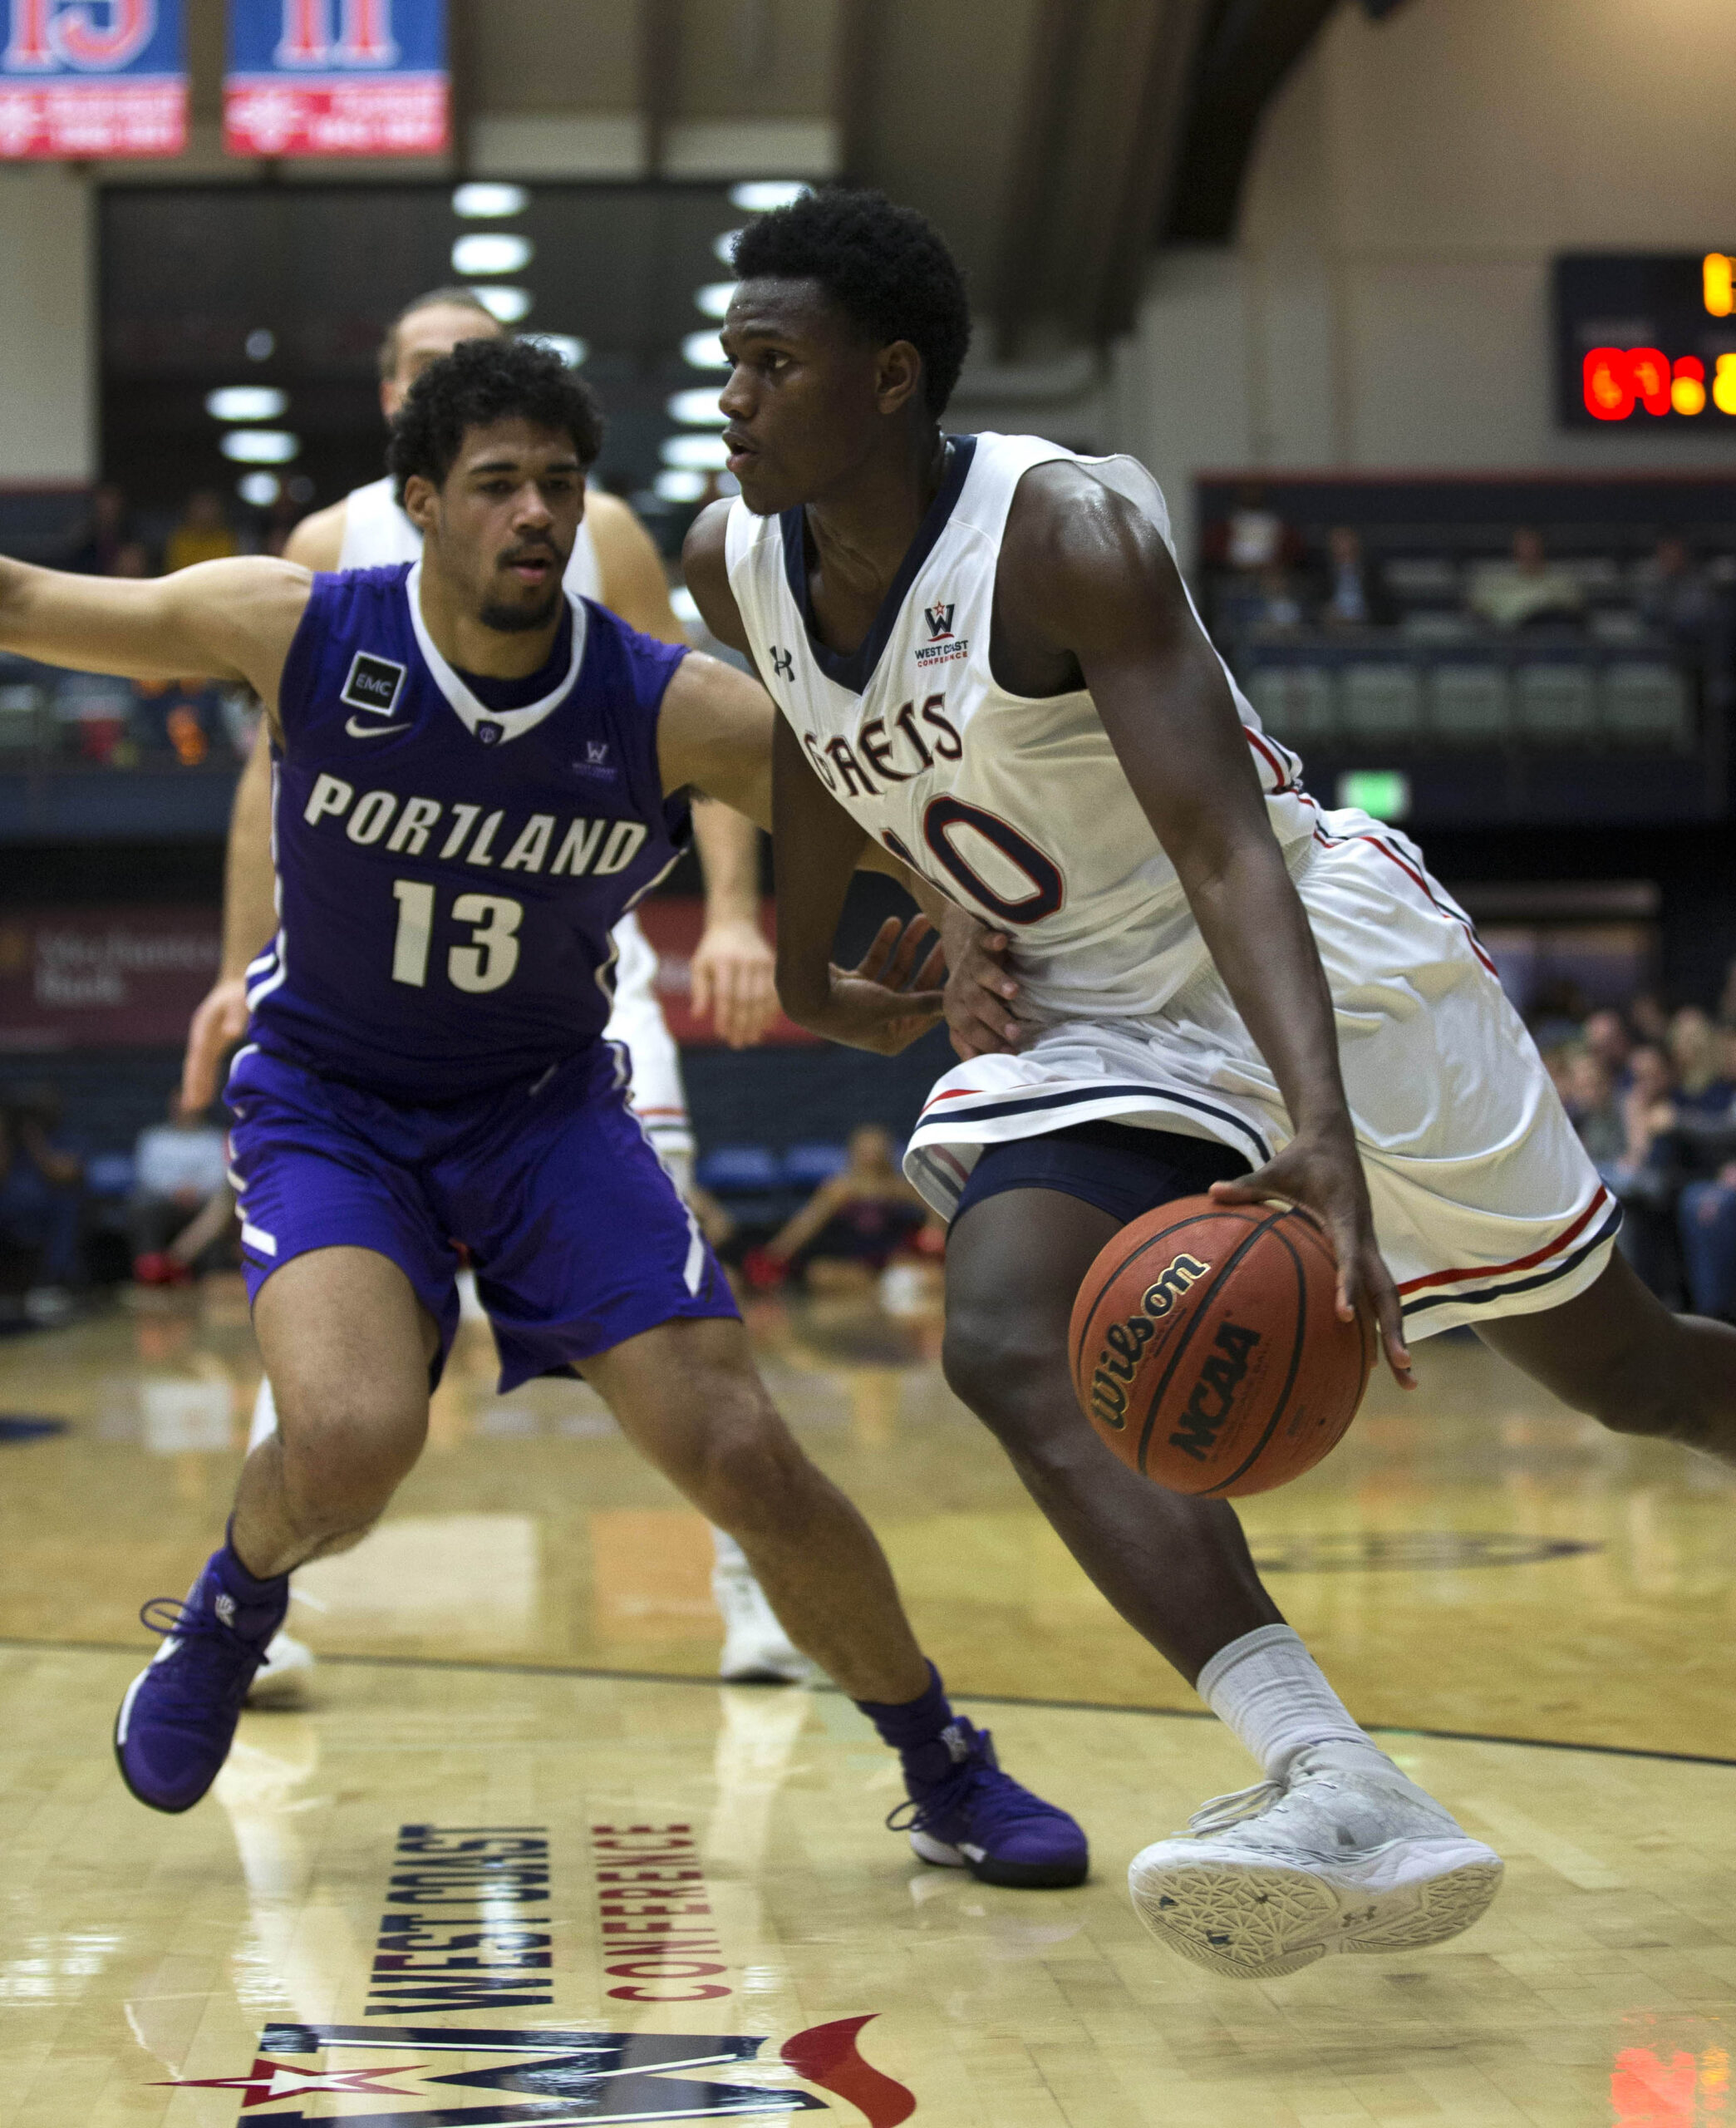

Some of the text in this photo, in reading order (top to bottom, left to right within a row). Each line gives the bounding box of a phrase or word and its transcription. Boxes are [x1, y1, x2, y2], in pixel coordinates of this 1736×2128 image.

[356, 672, 392, 697] EMC
[915, 640, 969, 660] WEST COAST
[303, 773, 647, 876] PORTLAND
[392, 879, 524, 993] 13
[1090, 1253, 1211, 1431] Wilson
[1168, 1320, 1261, 1461] NCAA
[364, 1825, 554, 2016] WEST COAST
[592, 1824, 732, 2002] CONFERENCE
